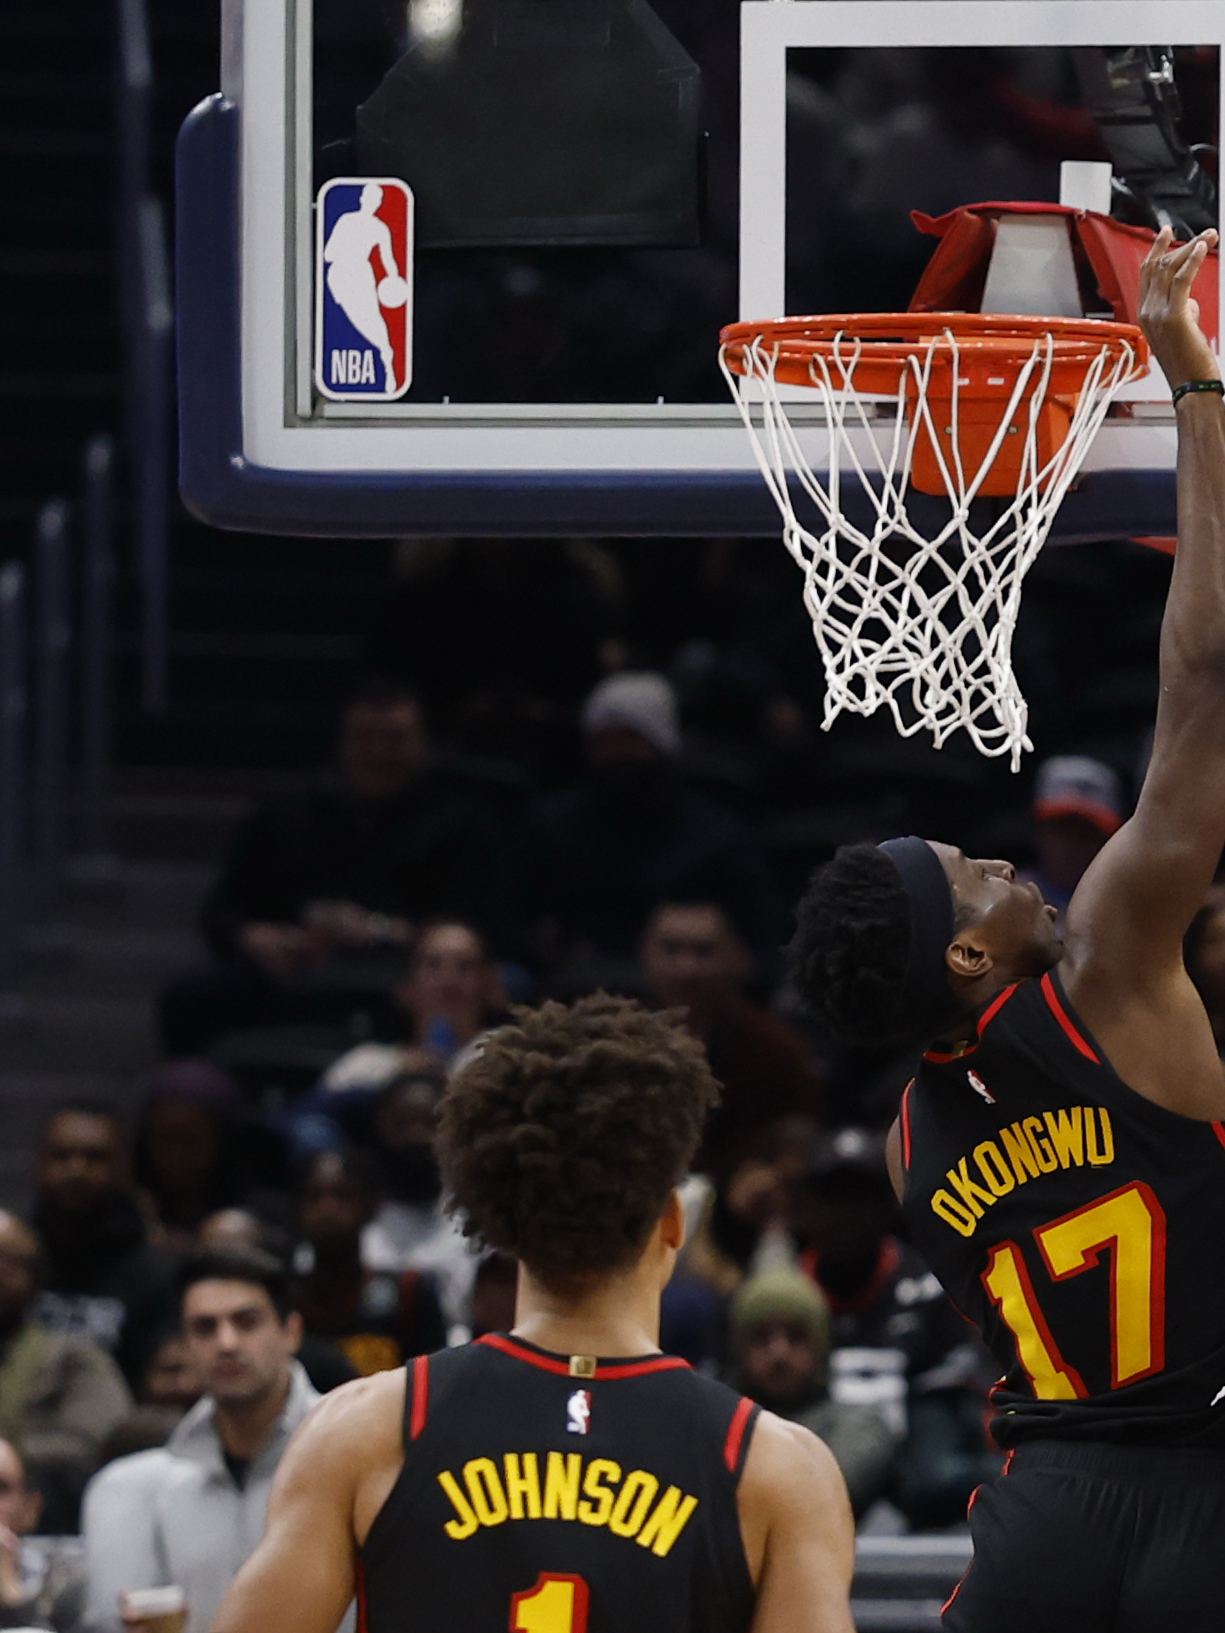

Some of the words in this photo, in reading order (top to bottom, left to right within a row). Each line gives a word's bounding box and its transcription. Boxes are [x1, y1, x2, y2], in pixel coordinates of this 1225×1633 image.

[331, 349, 376, 384] NBA
[931, 1106, 1115, 1238] OKONGWU
[980, 1180, 1167, 1400] 17
[437, 1451, 699, 1557] JOHNSON
